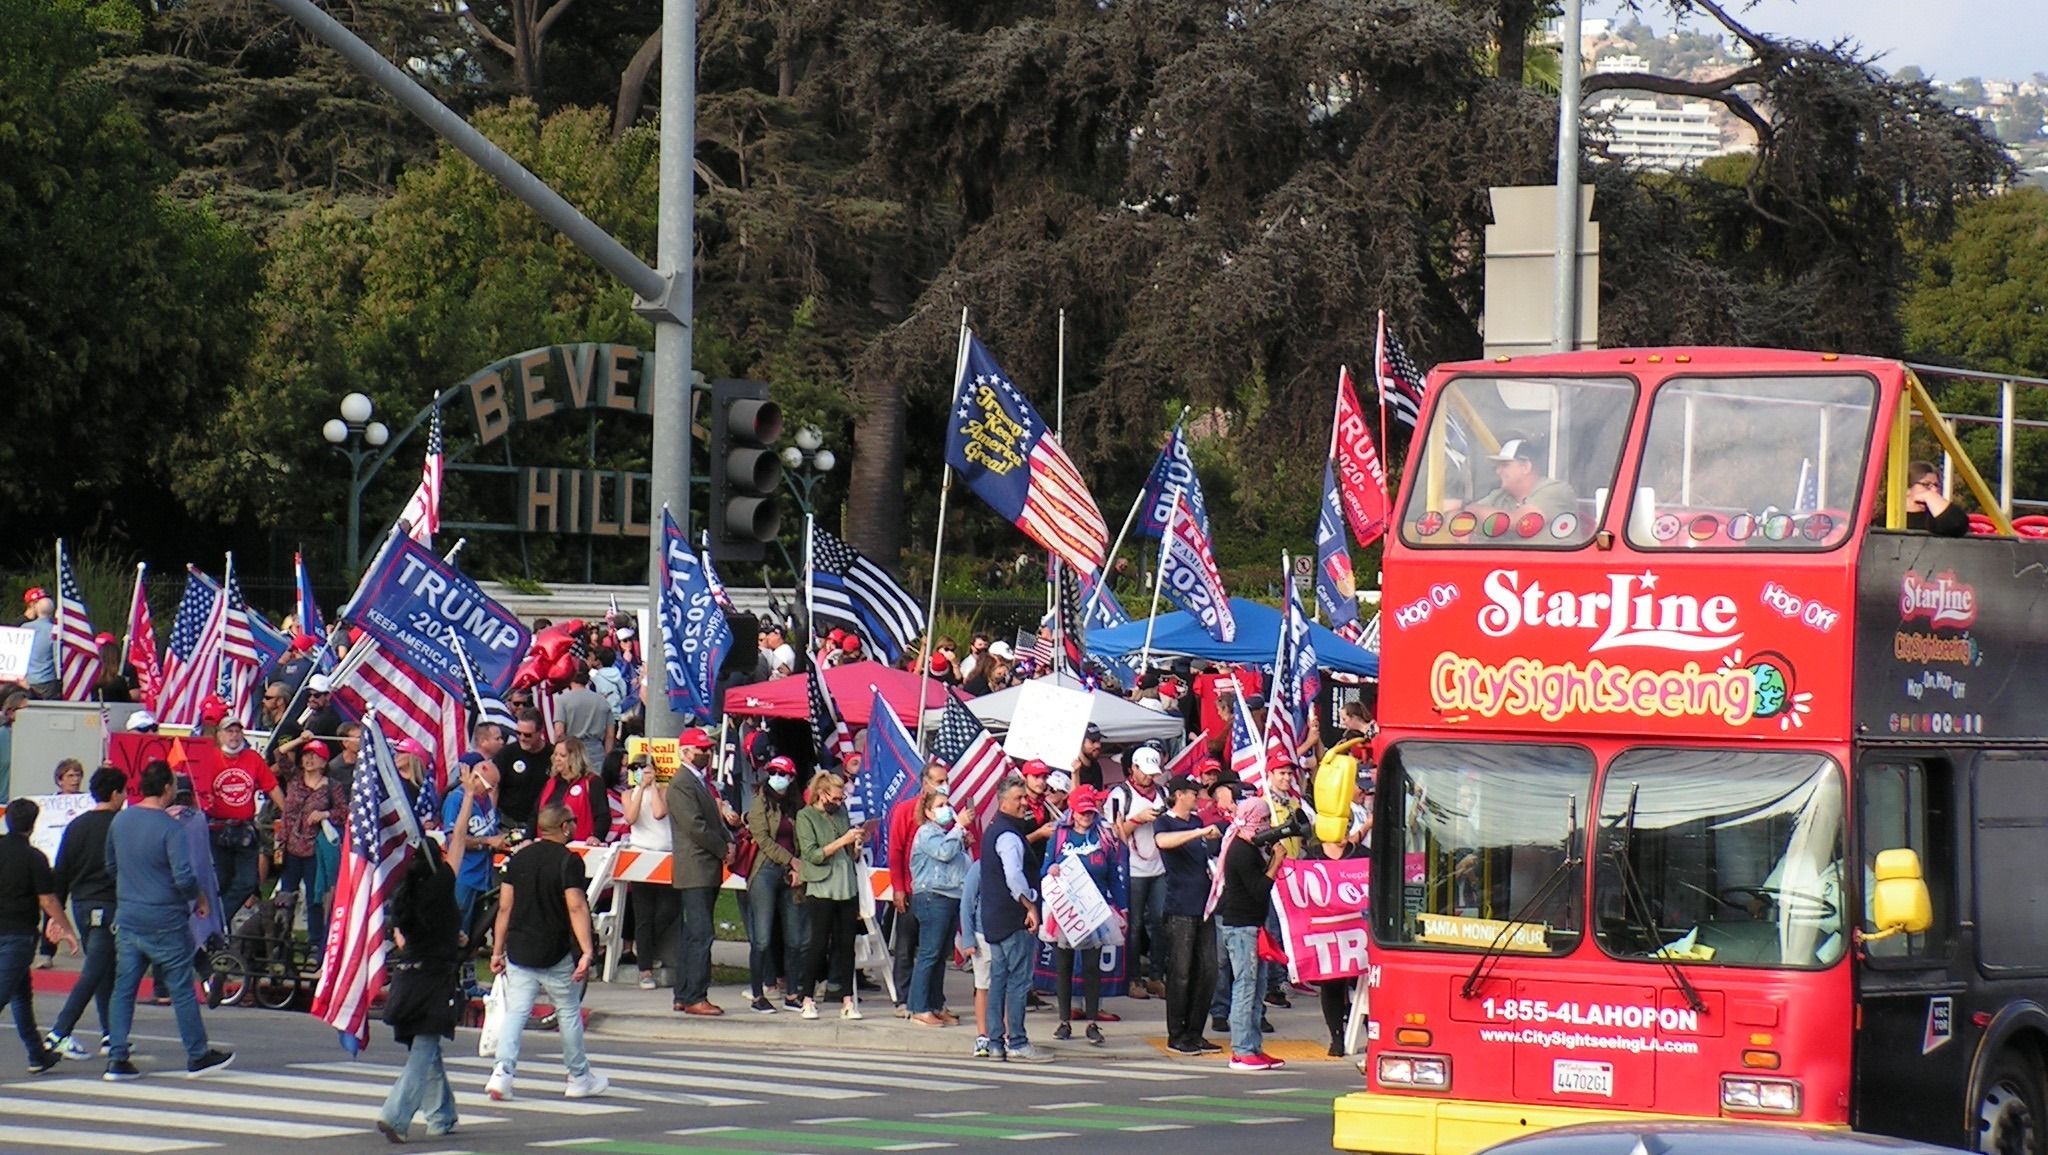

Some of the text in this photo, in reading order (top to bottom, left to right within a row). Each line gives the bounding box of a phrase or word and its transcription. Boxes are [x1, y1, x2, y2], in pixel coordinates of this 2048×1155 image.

[985, 412, 1015, 449] Keep
[528, 467, 651, 535] HILL
[397, 552, 520, 650] TRUMP
[1396, 583, 1459, 628] Hop On
[1478, 569, 1744, 652] StarLine
[1762, 583, 1838, 631] Hop Off
[1903, 577, 1974, 621] StarLine
[366, 608, 450, 669] KEEP AMERICA
[1431, 651, 1756, 727] CitySightseeing
[1907, 680, 1924, 700] Hop
[1936, 671, 1952, 692] Hop
[1953, 683, 1967, 699] Off
[1424, 920, 1456, 937] SANTA
[1482, 998, 1699, 1031] 1-855-4LAHOPON
[1480, 1029, 1699, 1054] www.CitySightseeingLA.com
